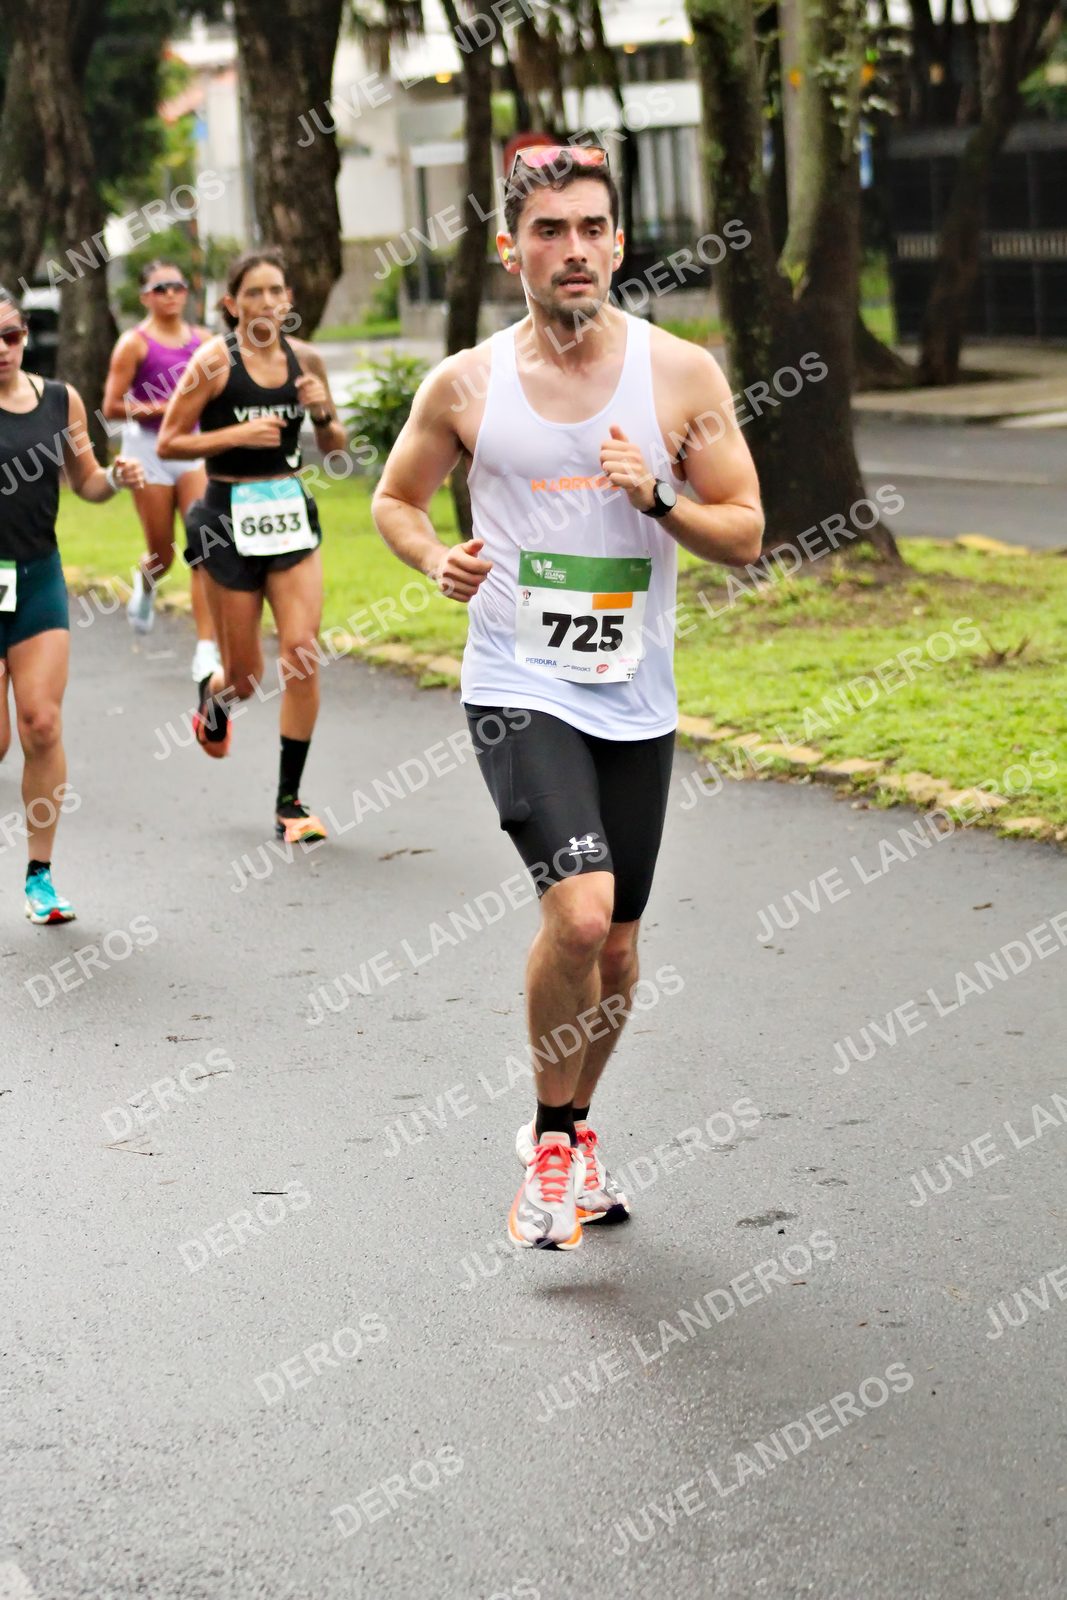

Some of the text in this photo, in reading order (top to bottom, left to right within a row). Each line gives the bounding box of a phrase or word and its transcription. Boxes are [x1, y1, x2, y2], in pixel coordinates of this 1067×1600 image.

[240, 512, 301, 536] 6633
[542, 611, 624, 652] 725
[525, 657, 557, 667] PERDURA
